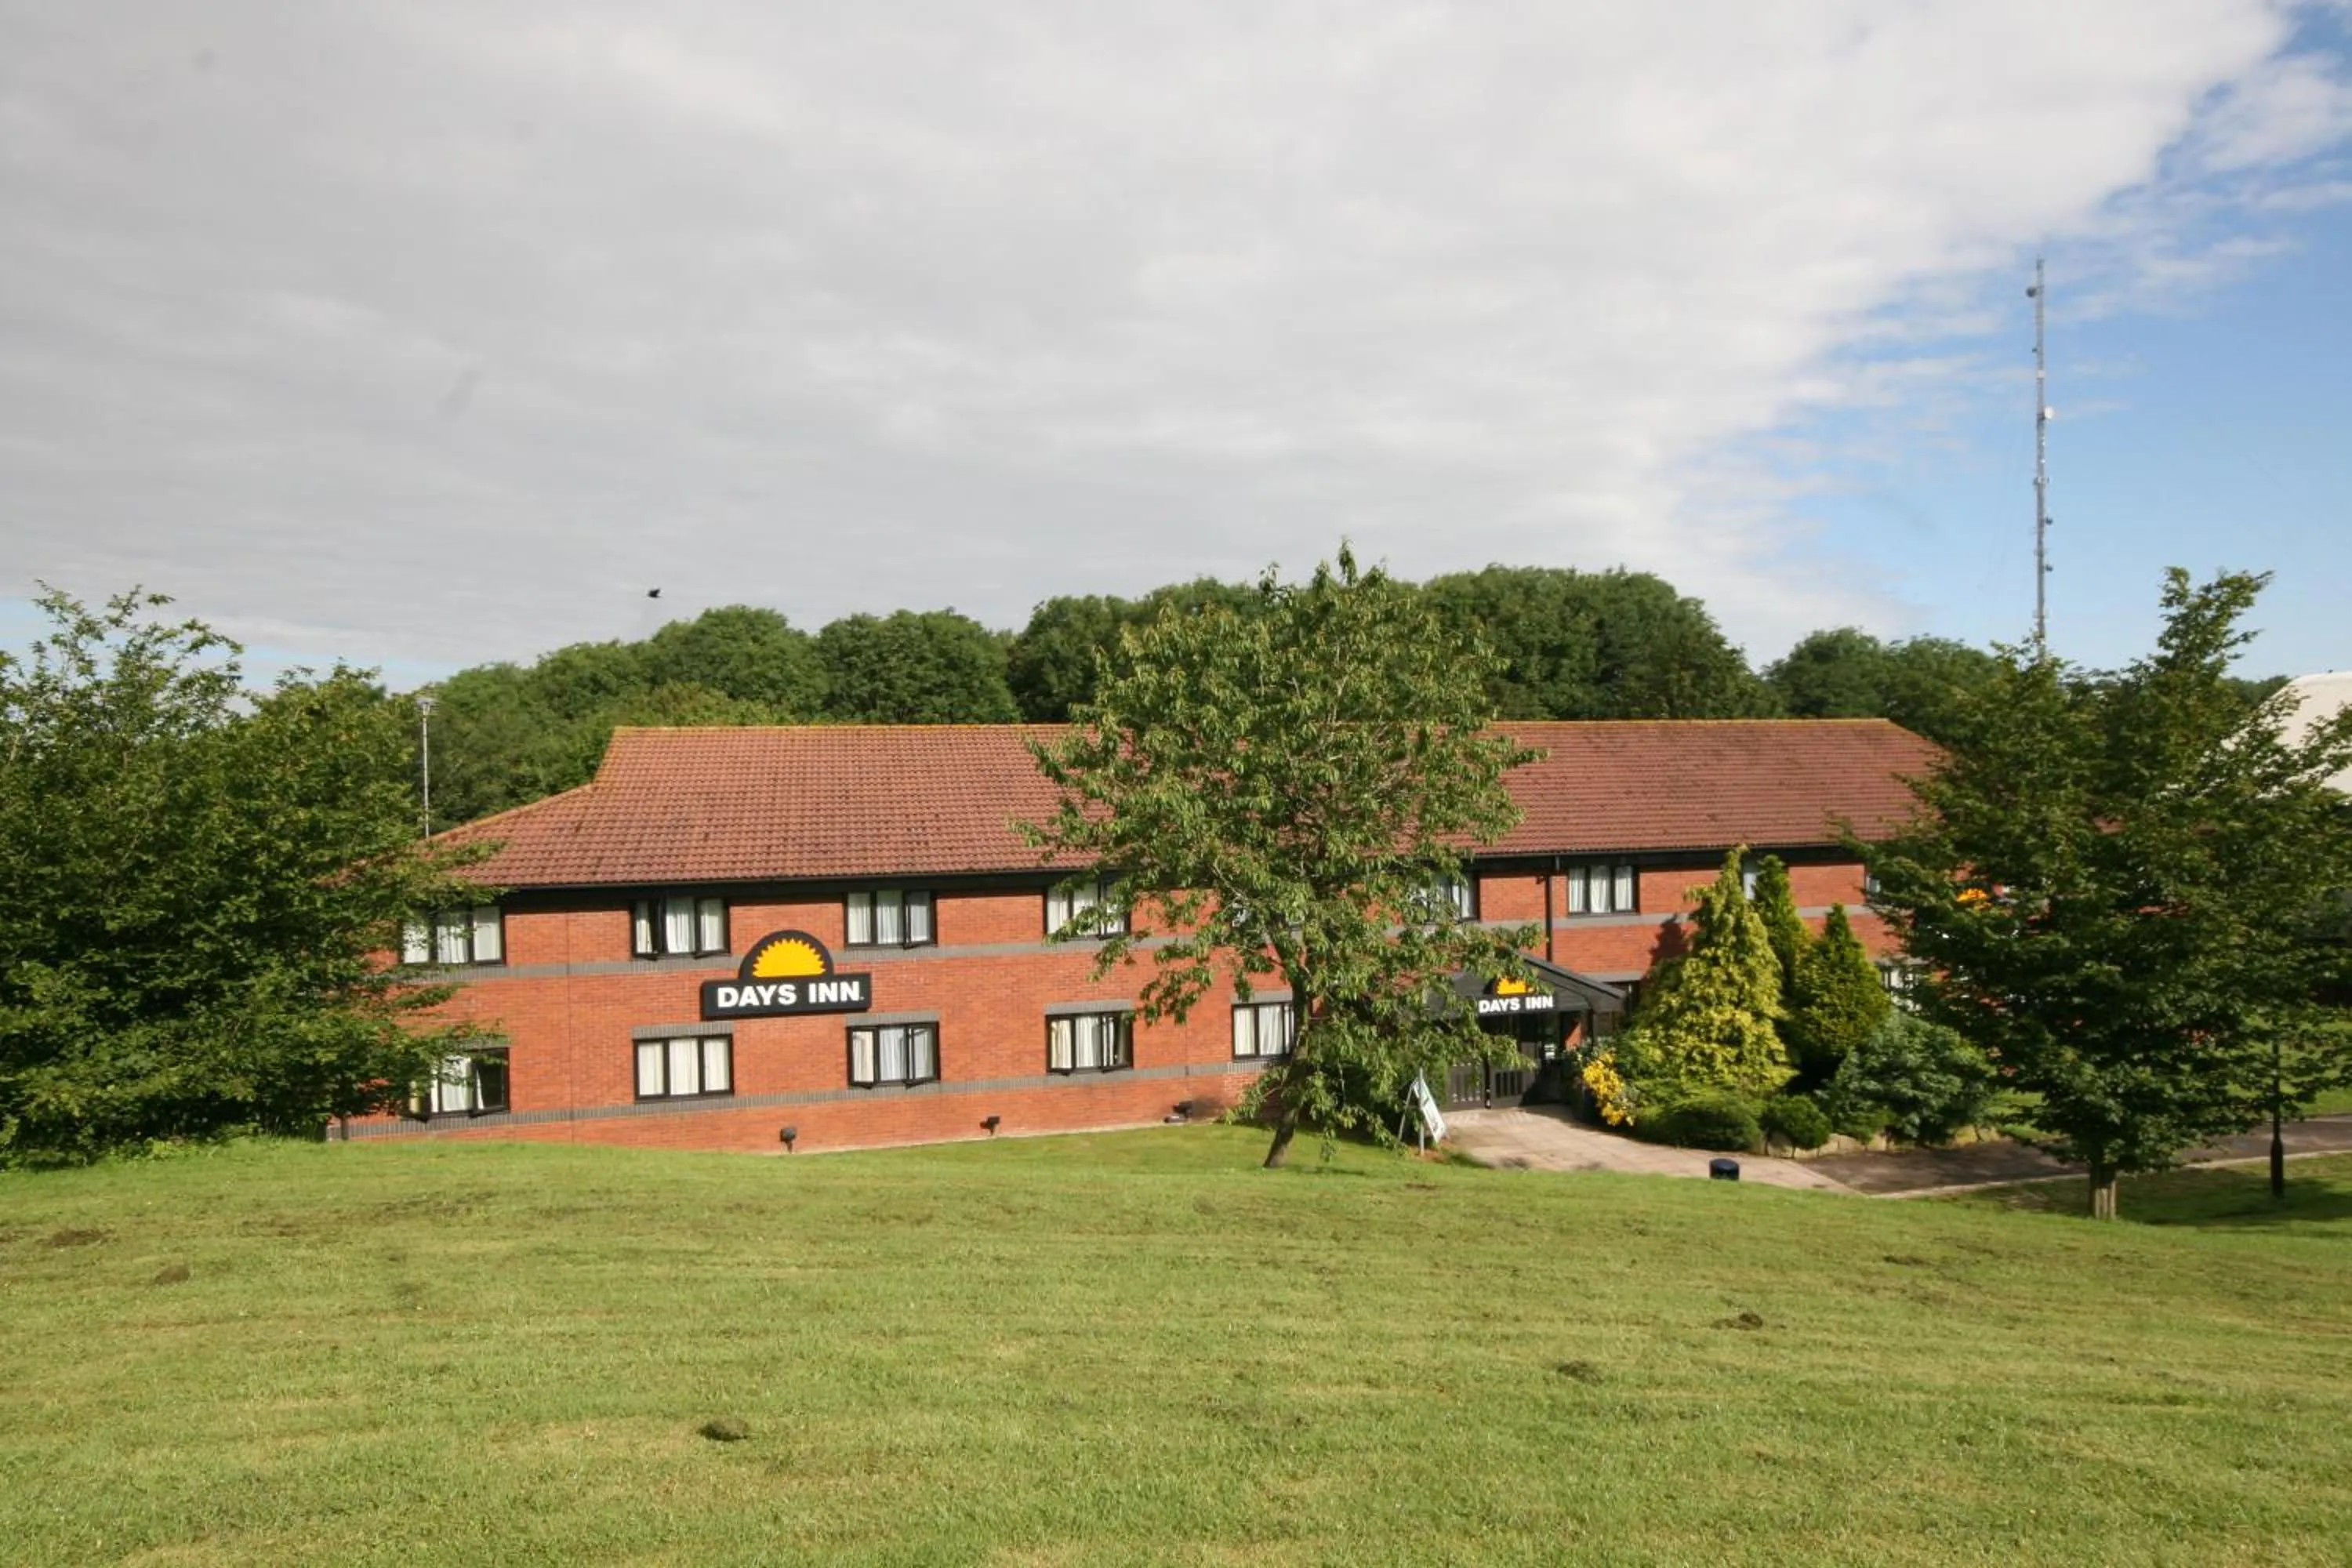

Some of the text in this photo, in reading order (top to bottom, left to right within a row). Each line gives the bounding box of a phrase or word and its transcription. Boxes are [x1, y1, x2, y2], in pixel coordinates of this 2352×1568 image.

[717, 981, 862, 1008] DAYS INN
[1479, 995, 1554, 1014] DAYS INN
